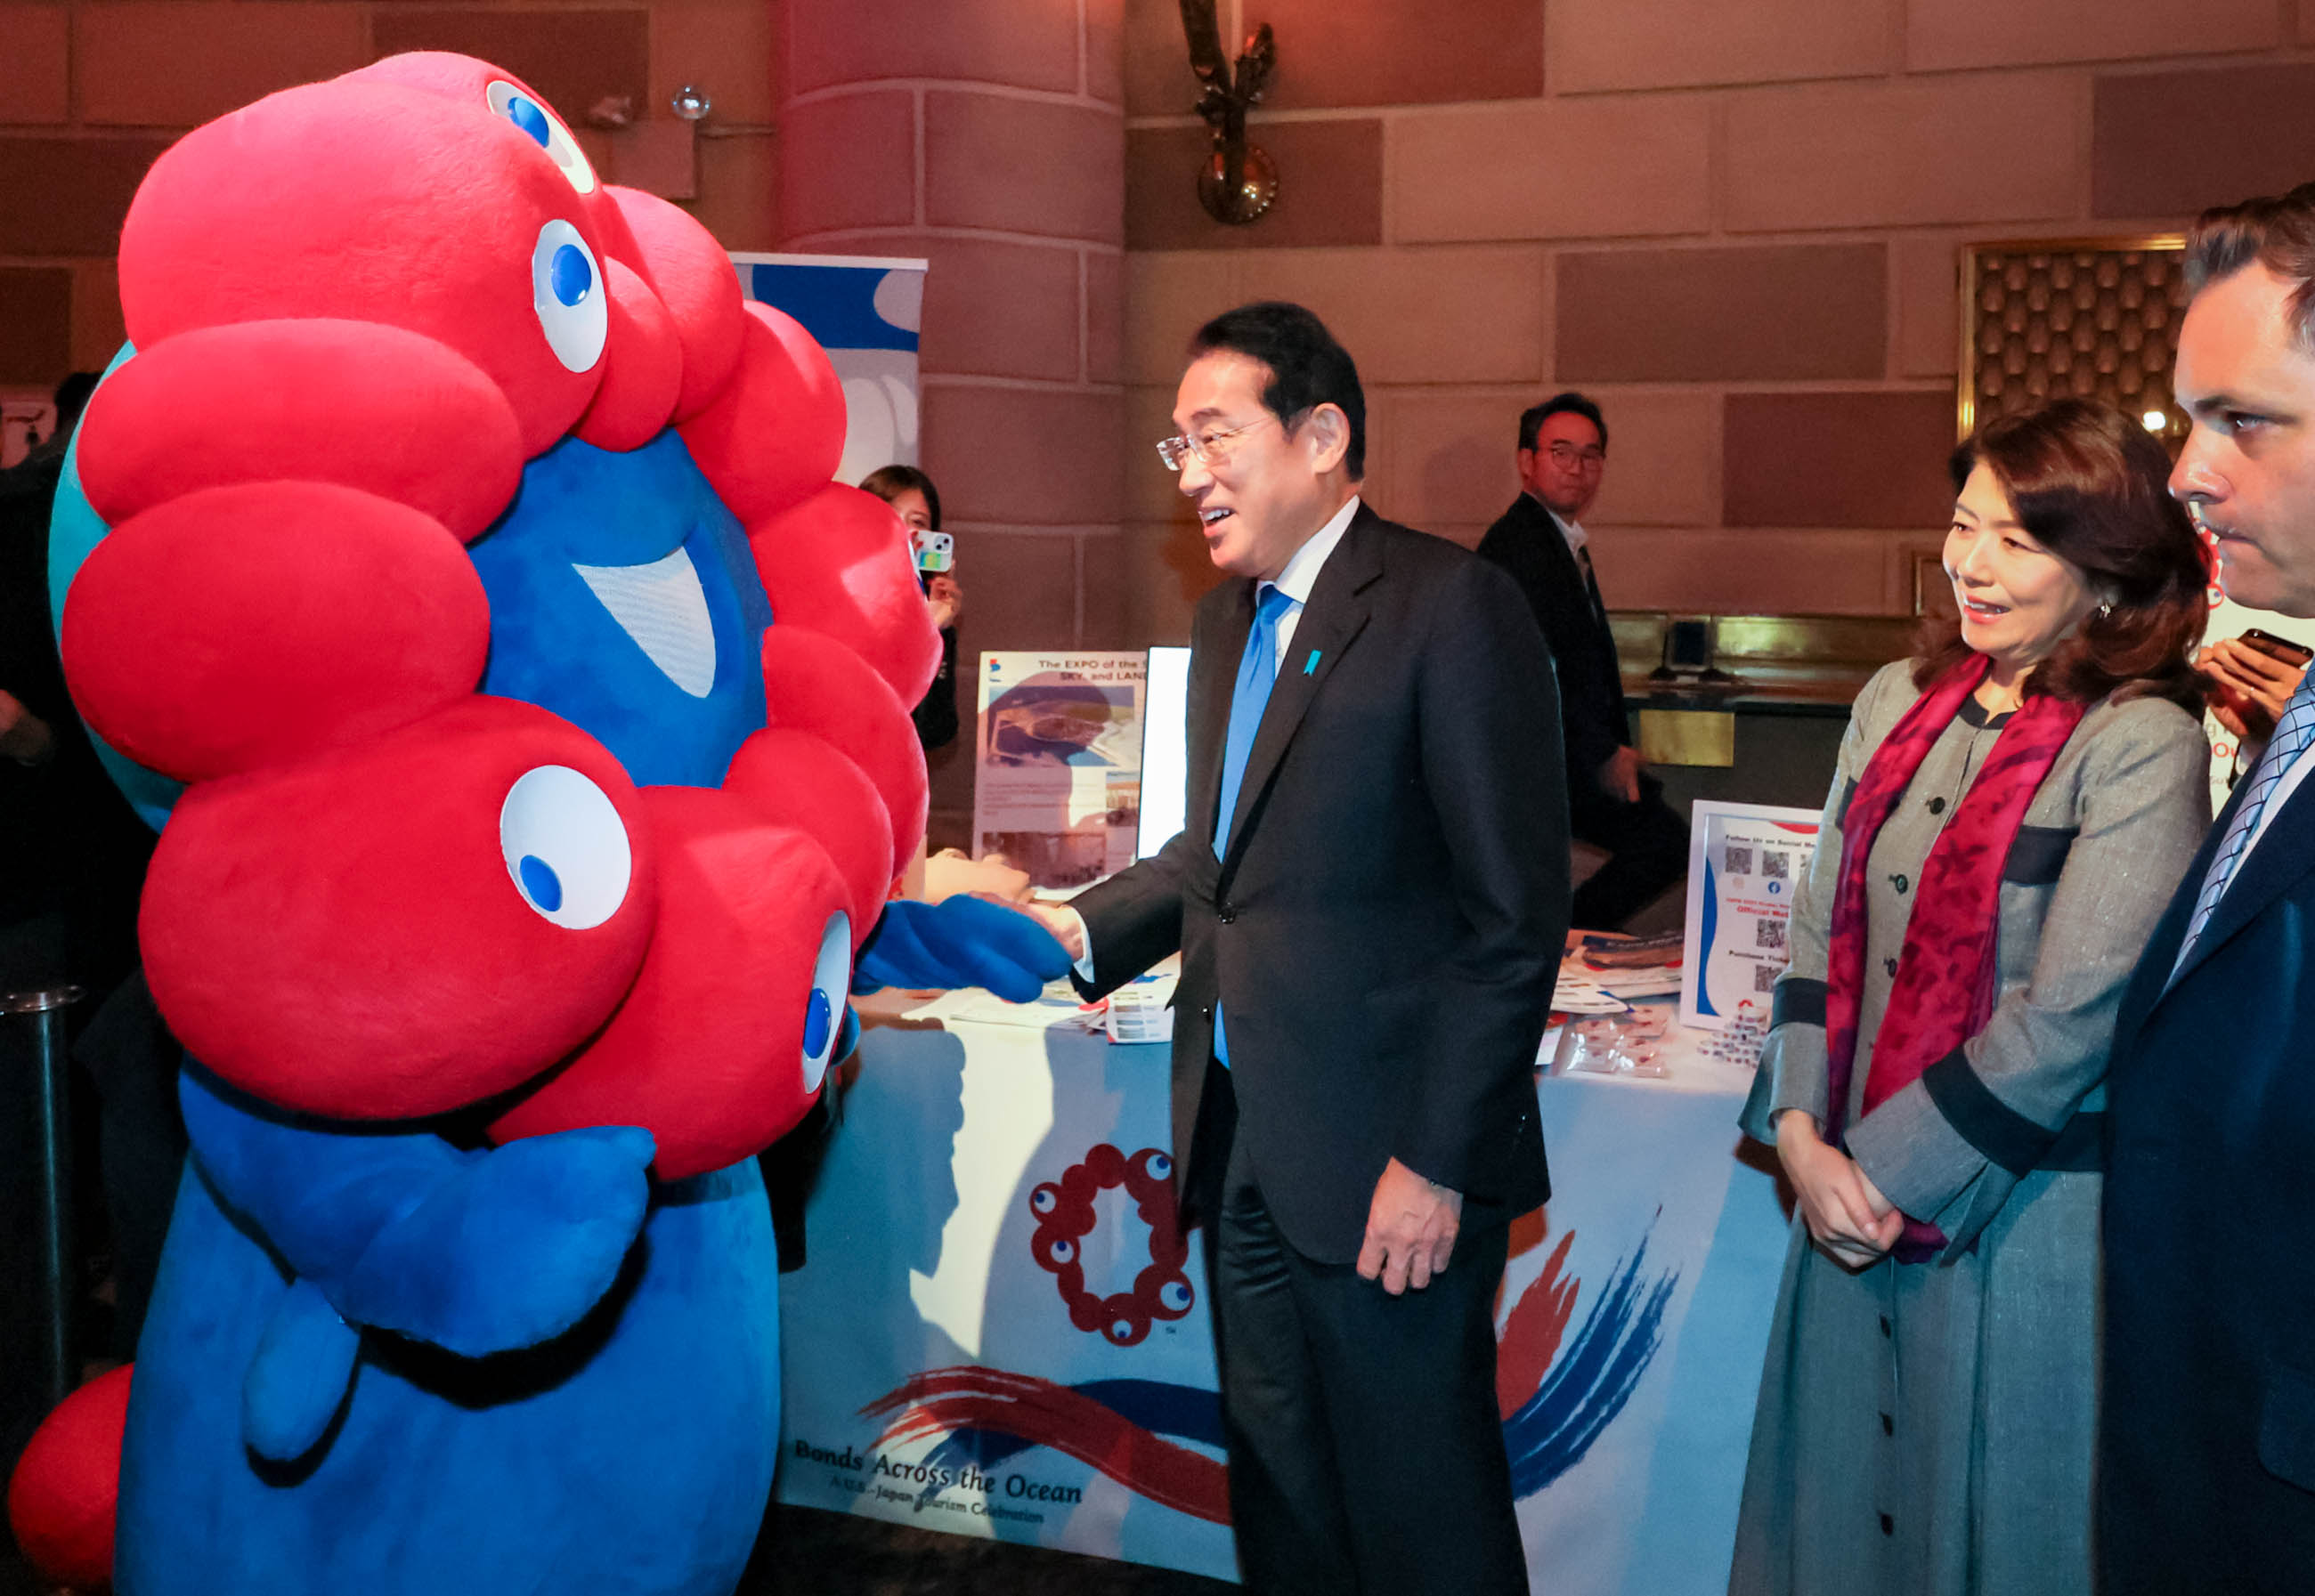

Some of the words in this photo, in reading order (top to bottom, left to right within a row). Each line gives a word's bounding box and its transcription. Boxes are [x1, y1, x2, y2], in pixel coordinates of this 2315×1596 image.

[1065, 660, 1099, 668] EXPO
[1119, 660, 1138, 668] the
[1091, 672, 1113, 680] and
[794, 1438, 864, 1470] Bonds
[874, 1454, 950, 1487] Across
[961, 1466, 996, 1494] the
[1005, 1473, 1083, 1504] Ocean
[918, 1494, 967, 1513] Tourism
[971, 1502, 1044, 1524] Celebration
